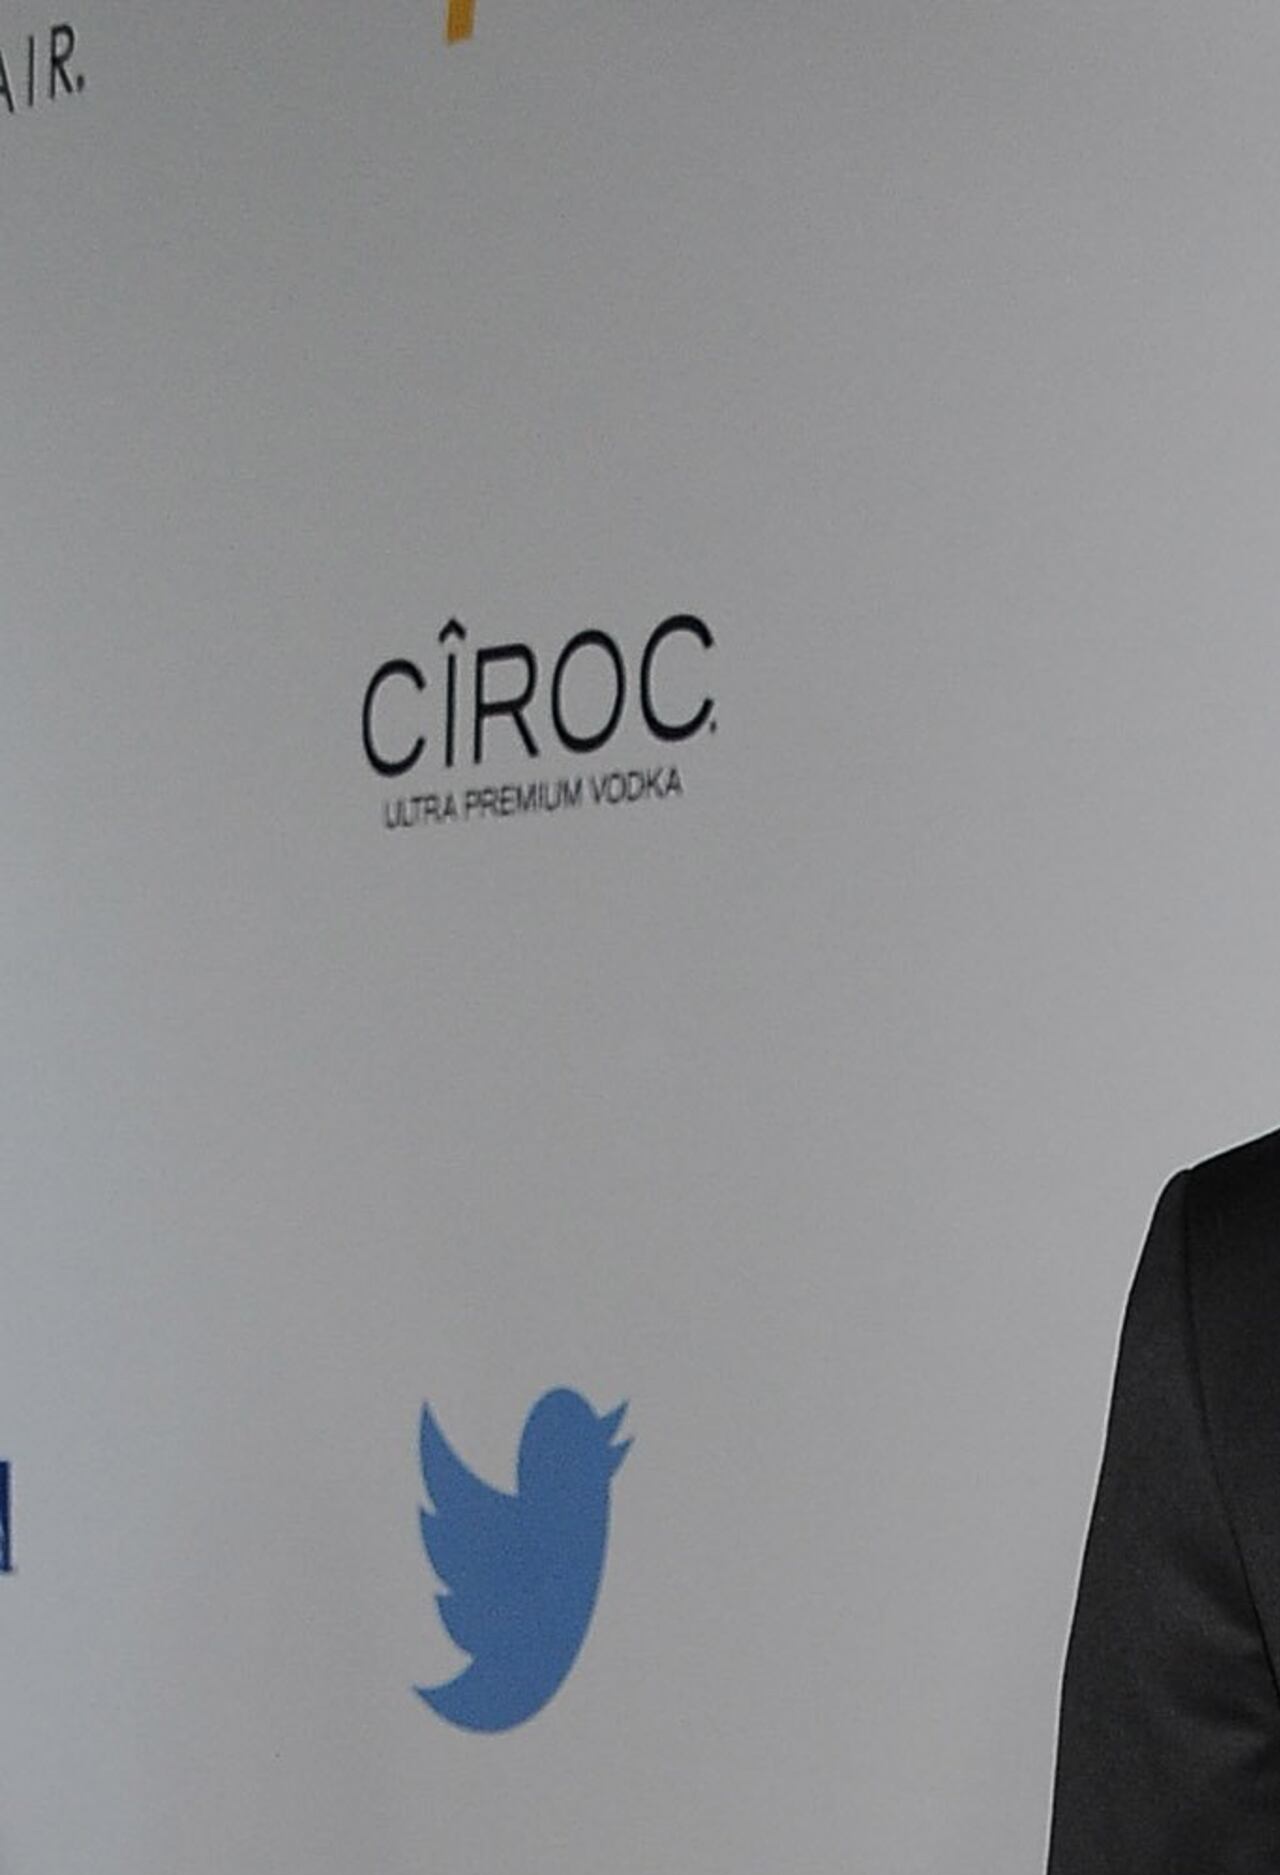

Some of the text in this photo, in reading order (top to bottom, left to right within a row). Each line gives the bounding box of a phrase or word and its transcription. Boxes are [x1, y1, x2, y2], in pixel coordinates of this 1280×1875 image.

[385, 766, 683, 829] ULTRA PREMIUM VODKA
